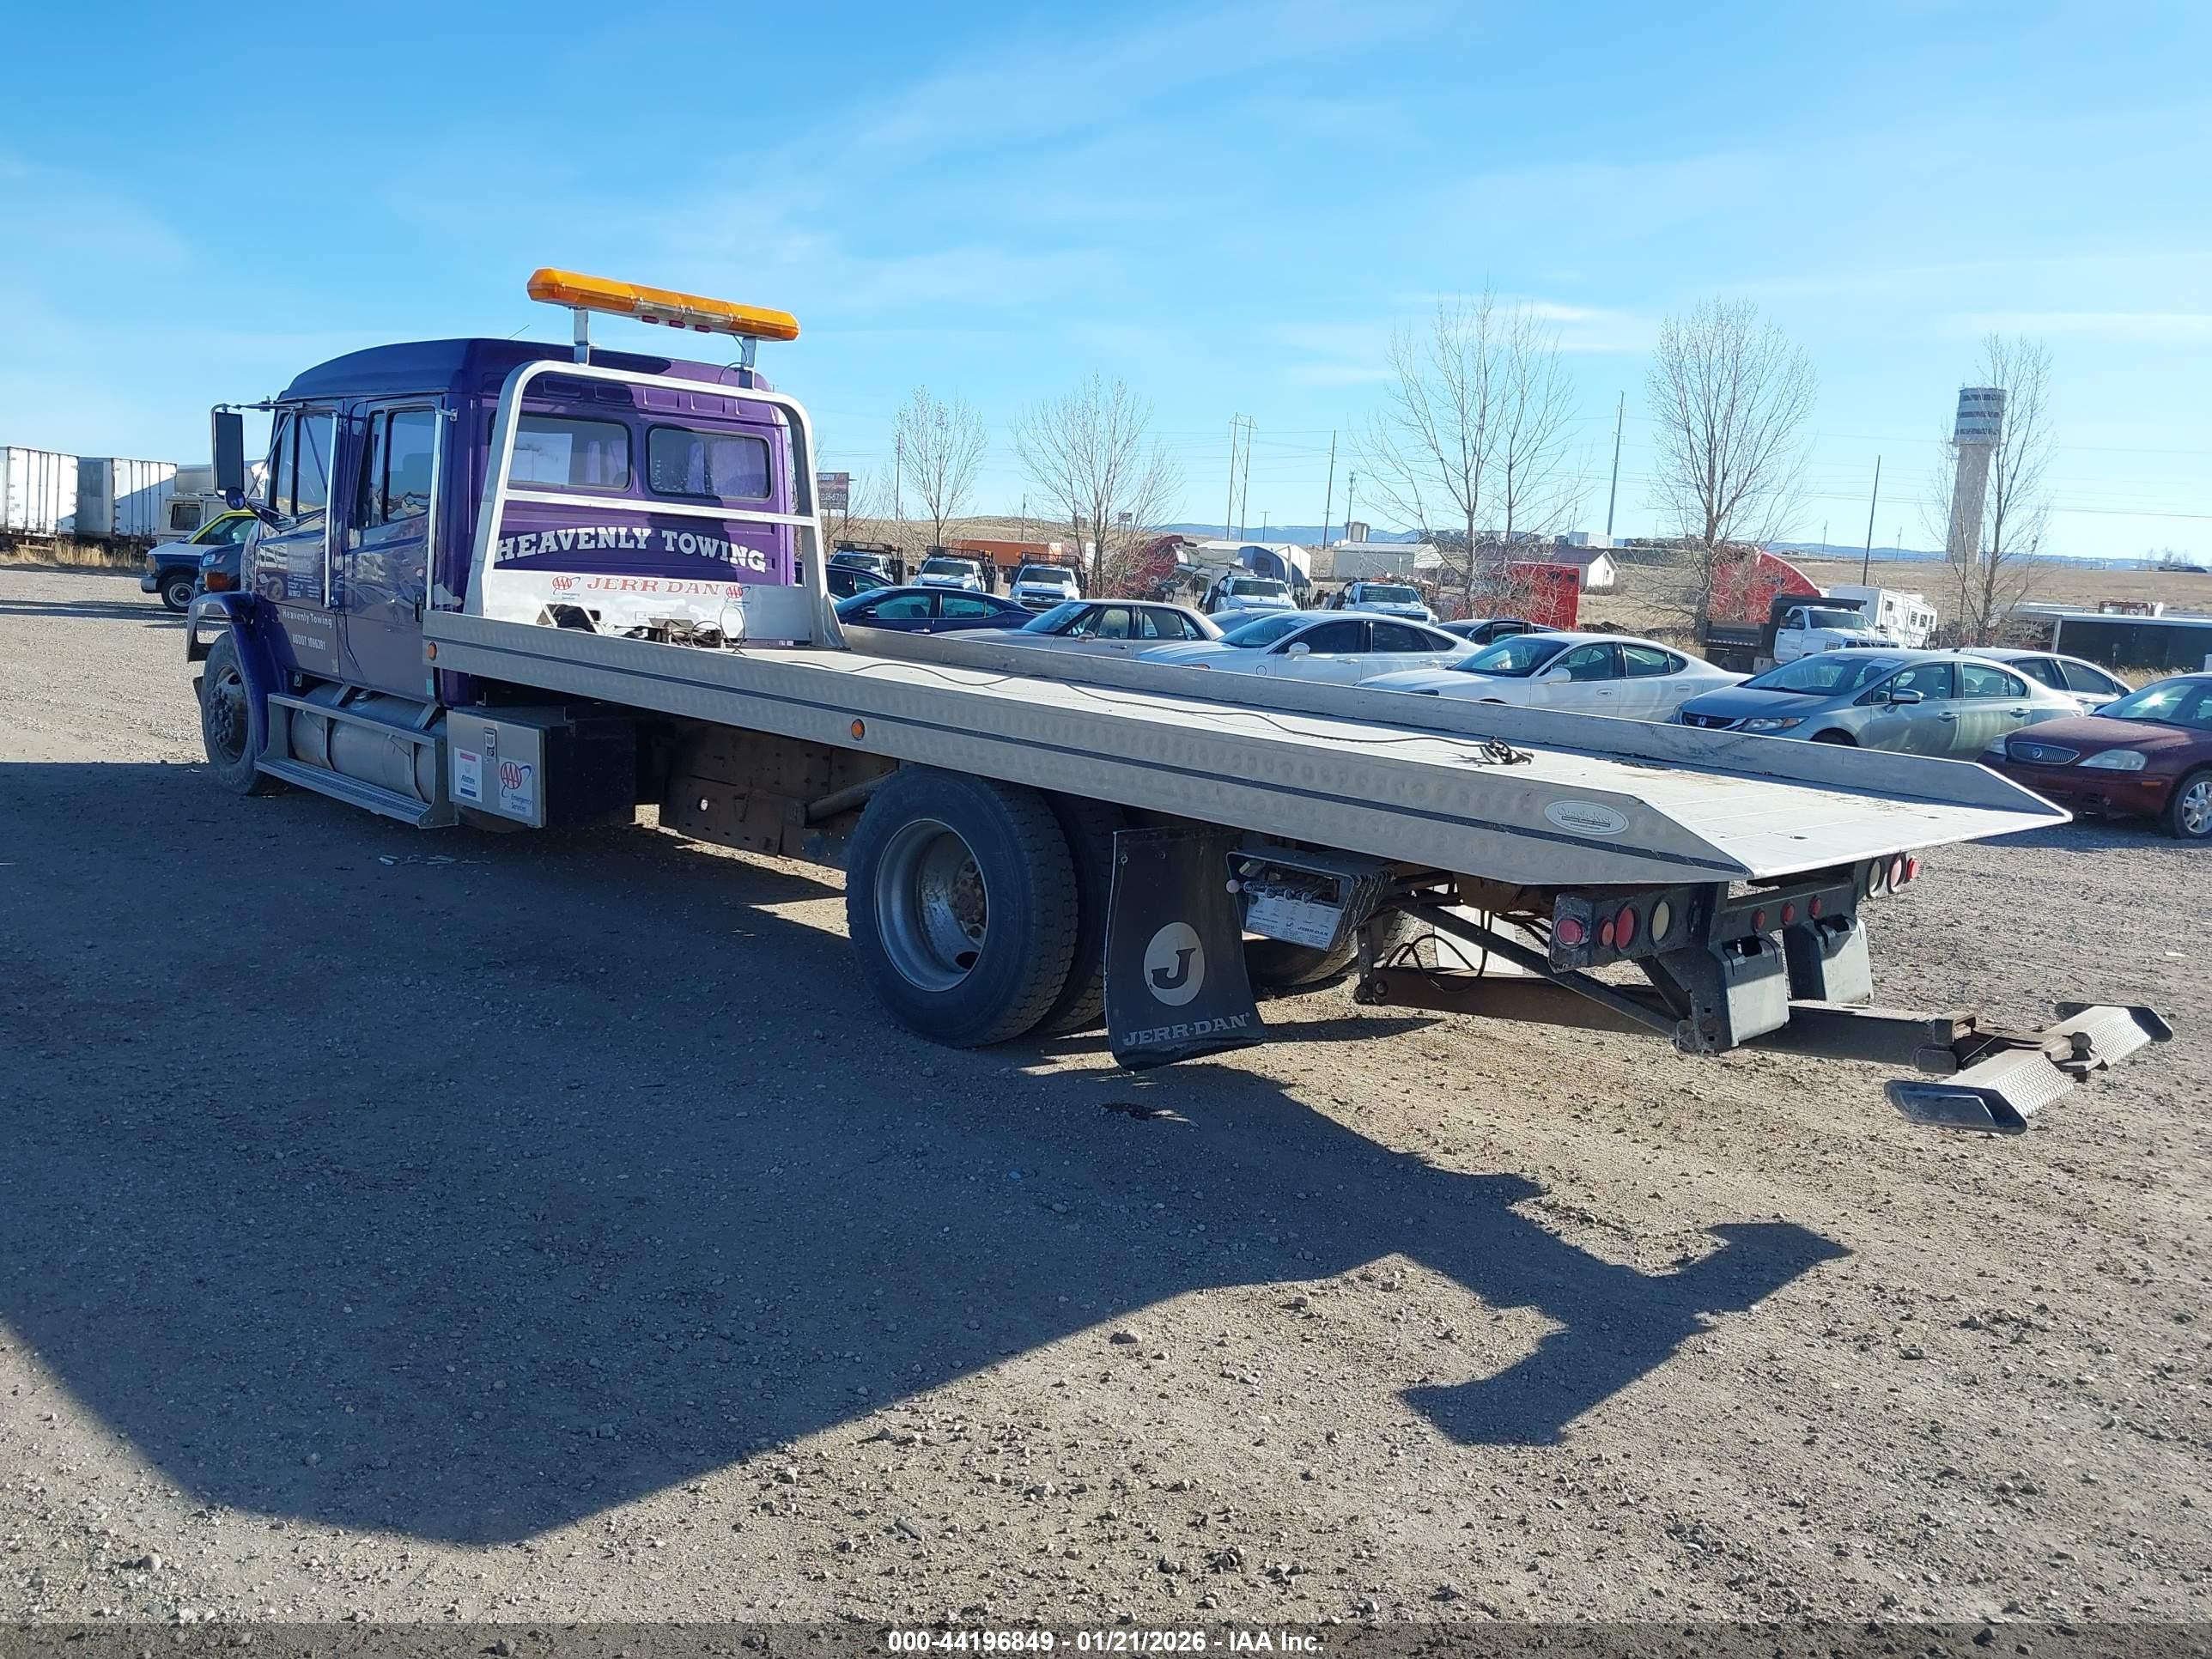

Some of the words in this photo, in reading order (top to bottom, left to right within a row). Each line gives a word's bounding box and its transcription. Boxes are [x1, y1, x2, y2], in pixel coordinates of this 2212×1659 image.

[495, 526, 653, 562] HEAVENLY
[661, 530, 767, 573] TOWING
[282, 608, 310, 625] Heavenly
[309, 613, 332, 629] Towing
[501, 762, 521, 788] AAA
[1151, 947, 1196, 989] J
[1123, 1013, 1249, 1046] JERR-DAN
